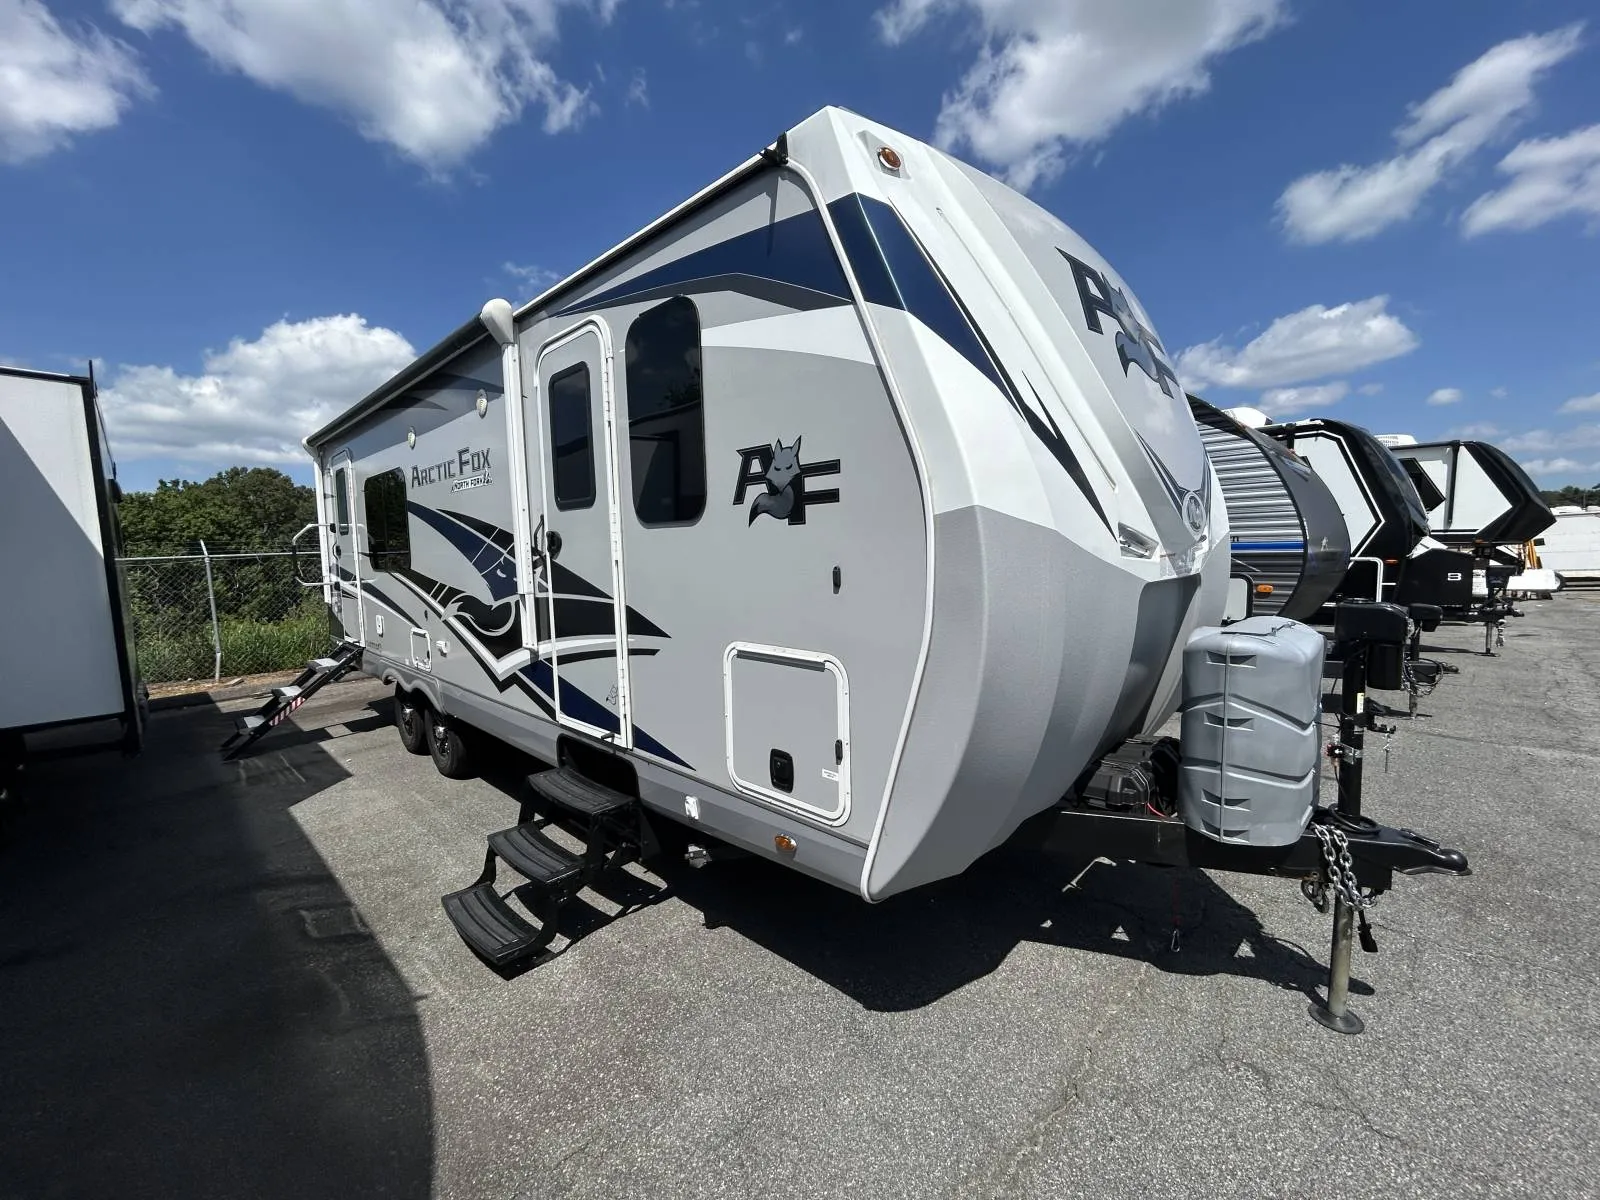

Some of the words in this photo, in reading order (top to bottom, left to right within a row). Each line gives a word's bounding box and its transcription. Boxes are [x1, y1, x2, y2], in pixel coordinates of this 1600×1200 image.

[411, 459, 456, 489] ARCTIC
[457, 447, 491, 475] FOX
[454, 480, 470, 490] NORTH
